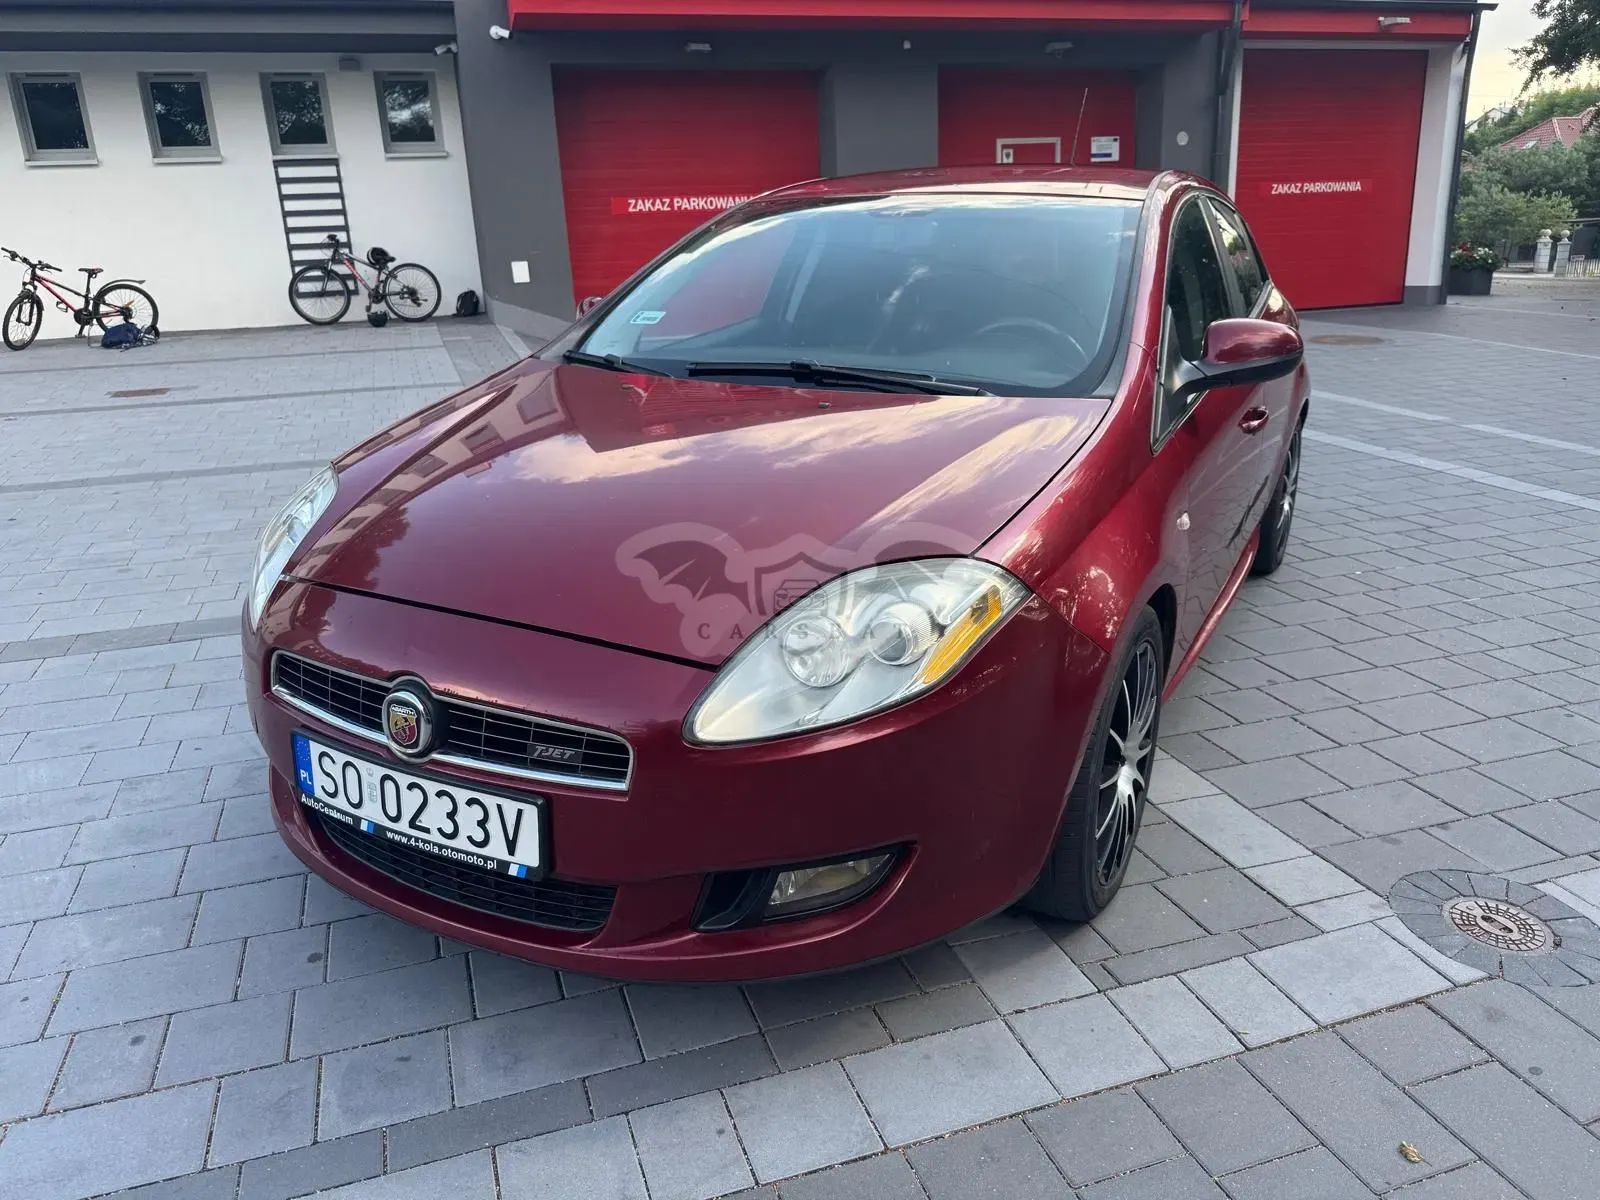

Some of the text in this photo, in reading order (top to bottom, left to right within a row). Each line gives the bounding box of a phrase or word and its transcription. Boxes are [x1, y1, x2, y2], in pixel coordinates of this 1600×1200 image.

[1271, 181, 1361, 195] ZAKAZ PARKOWANIA
[628, 198, 671, 212] ZAKAZ
[300, 769, 312, 785] PL
[301, 793, 353, 825] AutoCentrum
[318, 750, 524, 857] SO 0233V
[386, 830, 498, 870] www.4-kola.otomoto.pl
